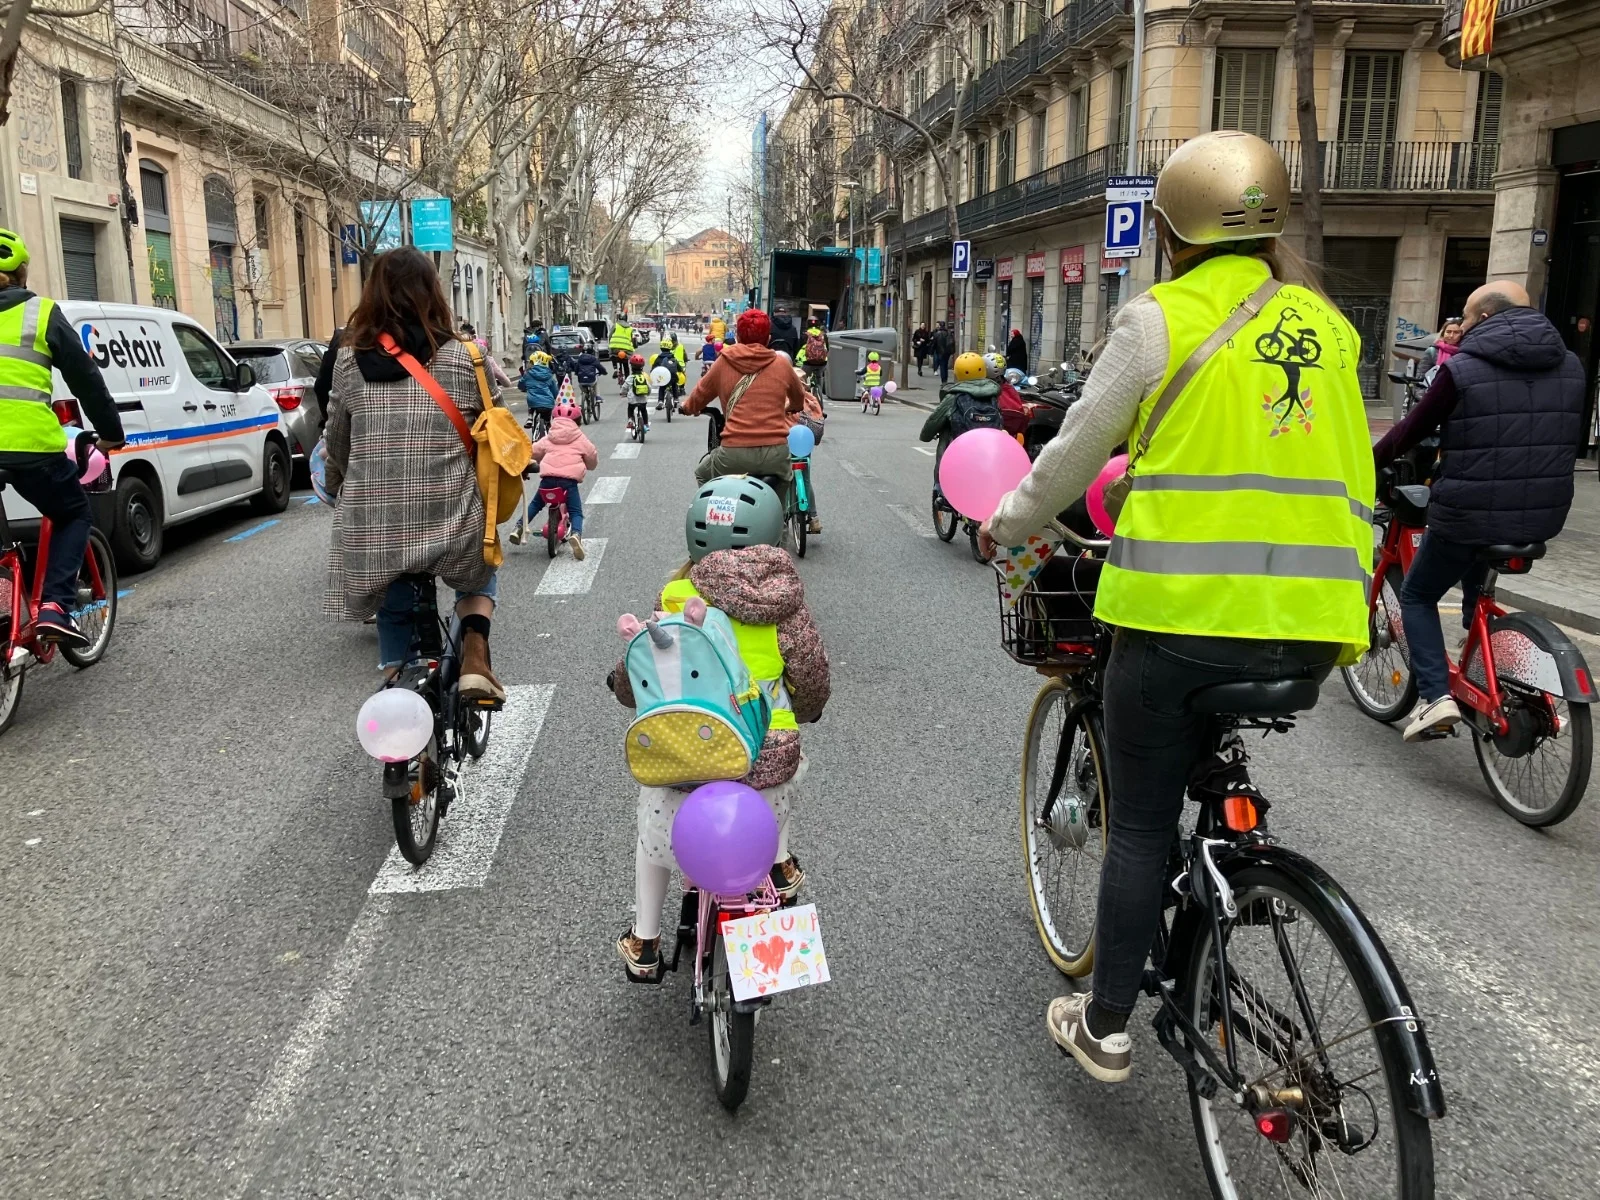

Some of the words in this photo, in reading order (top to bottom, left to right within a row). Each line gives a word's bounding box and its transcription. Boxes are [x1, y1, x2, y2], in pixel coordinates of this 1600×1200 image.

[1112, 207, 1135, 244] P
[955, 245, 966, 268] P
[1064, 263, 1083, 272] SUPER
[81, 323, 166, 369] Getair
[1326, 316, 1347, 369] VELLA
[147, 375, 171, 387] HVAC
[220, 404, 237, 418] STAFF
